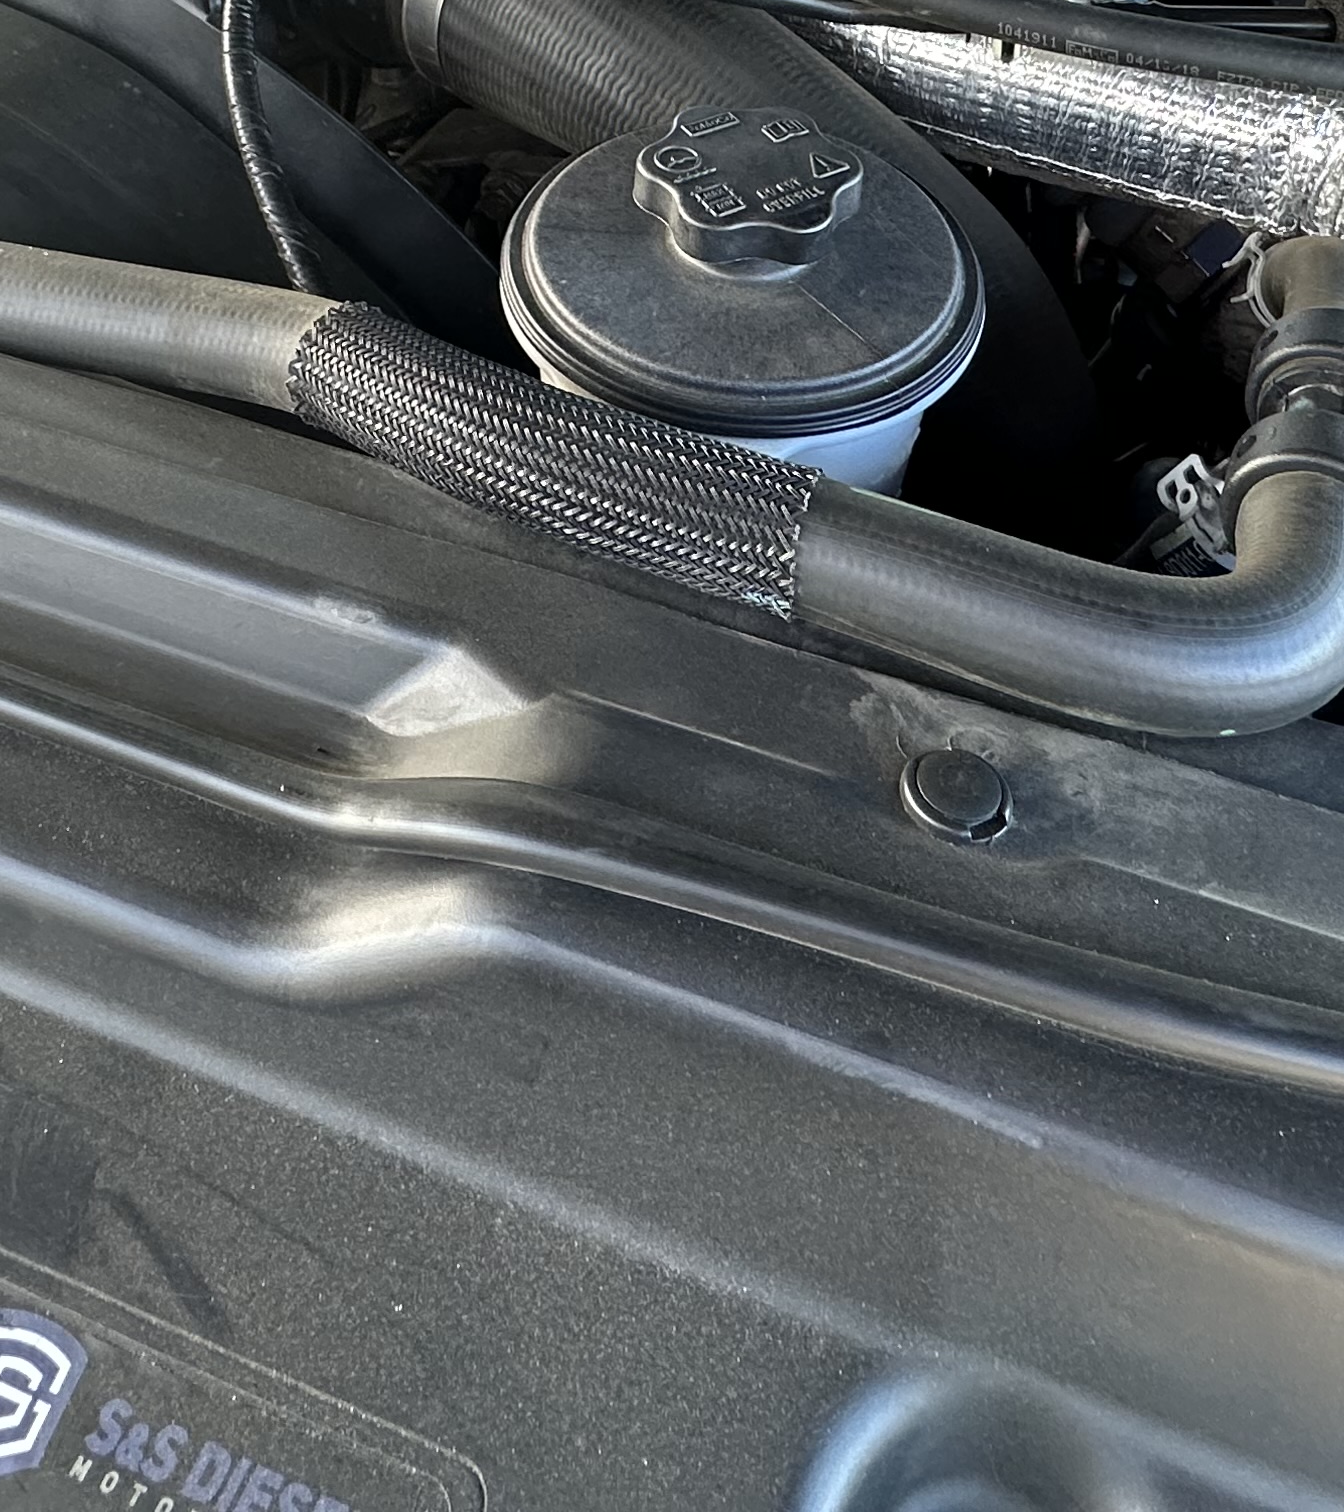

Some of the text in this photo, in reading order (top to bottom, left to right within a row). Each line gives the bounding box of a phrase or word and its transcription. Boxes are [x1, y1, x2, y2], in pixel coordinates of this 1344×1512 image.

[997, 22, 1058, 49] 1041911
[762, 186, 826, 214] OVERFILL
[84, 1398, 189, 1483] S&S
[68, 1454, 198, 1512] MOTO
